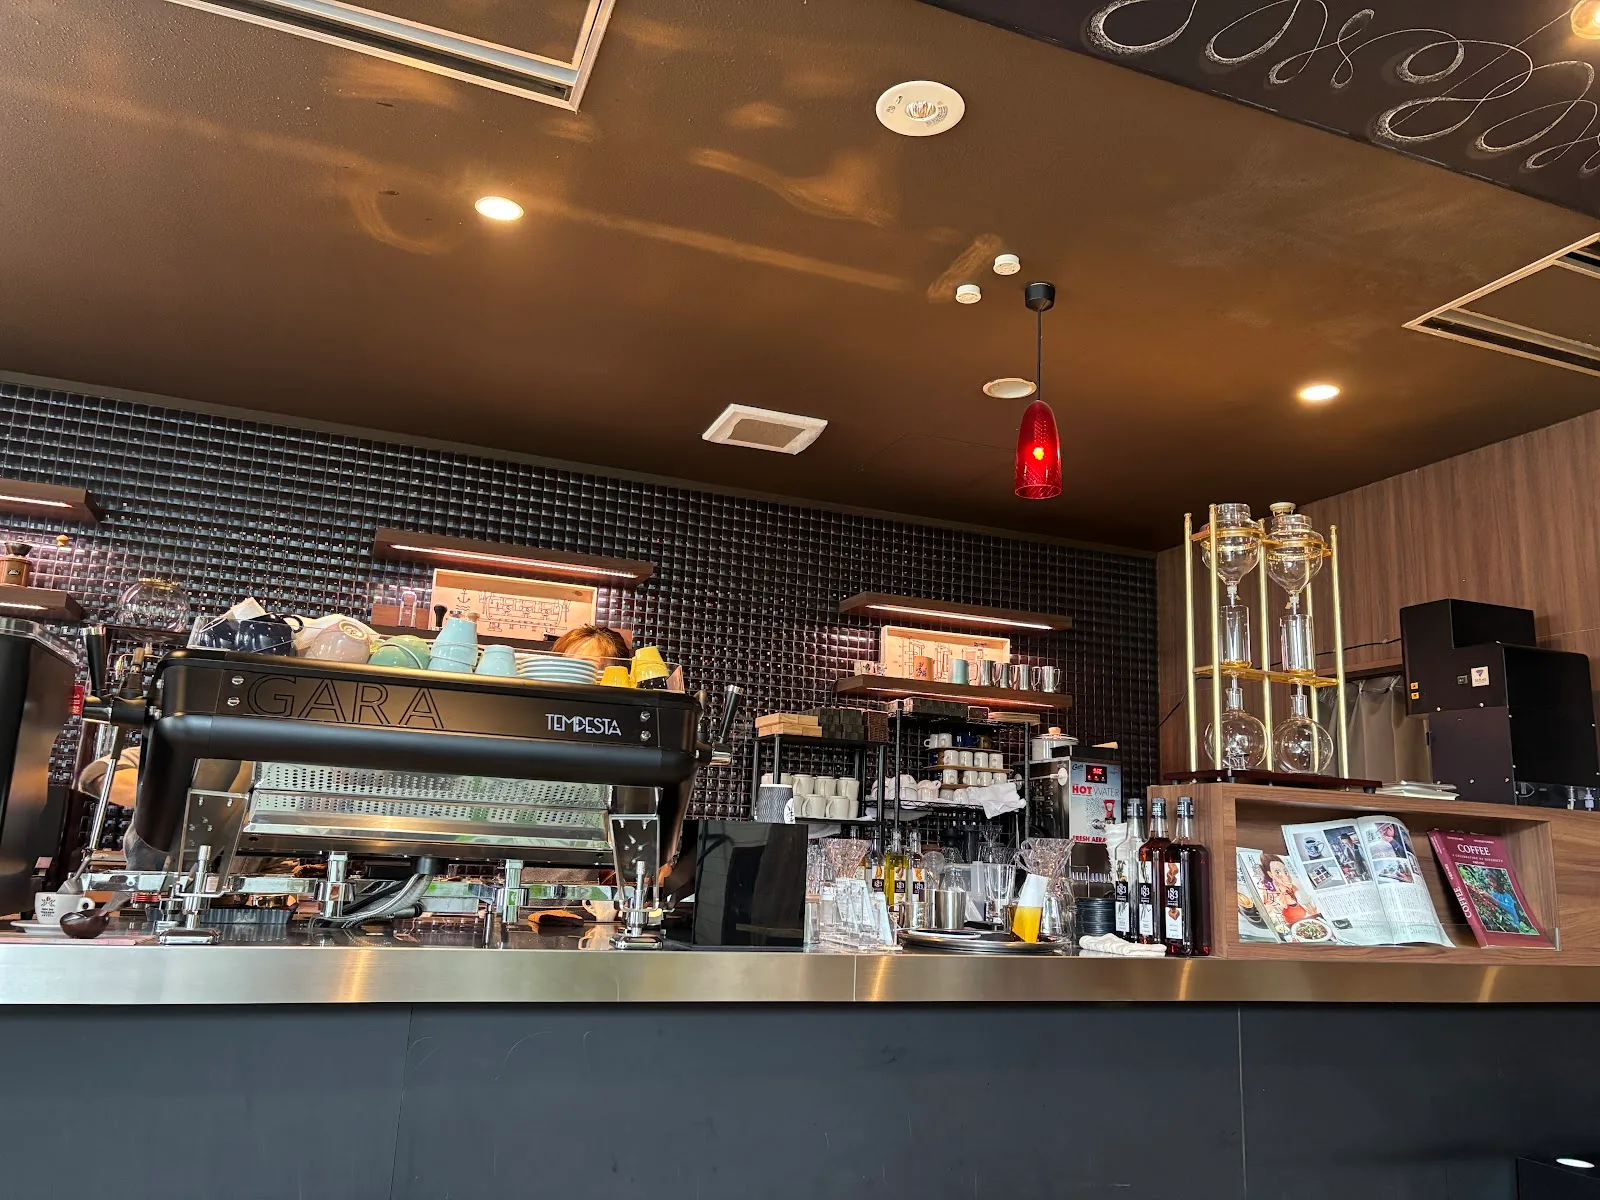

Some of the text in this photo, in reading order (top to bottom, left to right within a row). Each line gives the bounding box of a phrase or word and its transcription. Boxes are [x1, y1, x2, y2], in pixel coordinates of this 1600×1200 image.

[247, 674, 445, 729] GARA
[545, 713, 622, 736] TEMPESTA
[1072, 785, 1120, 797] HOT WATER
[1457, 843, 1491, 856] COFFEE
[1453, 886, 1472, 918] COFFEE
